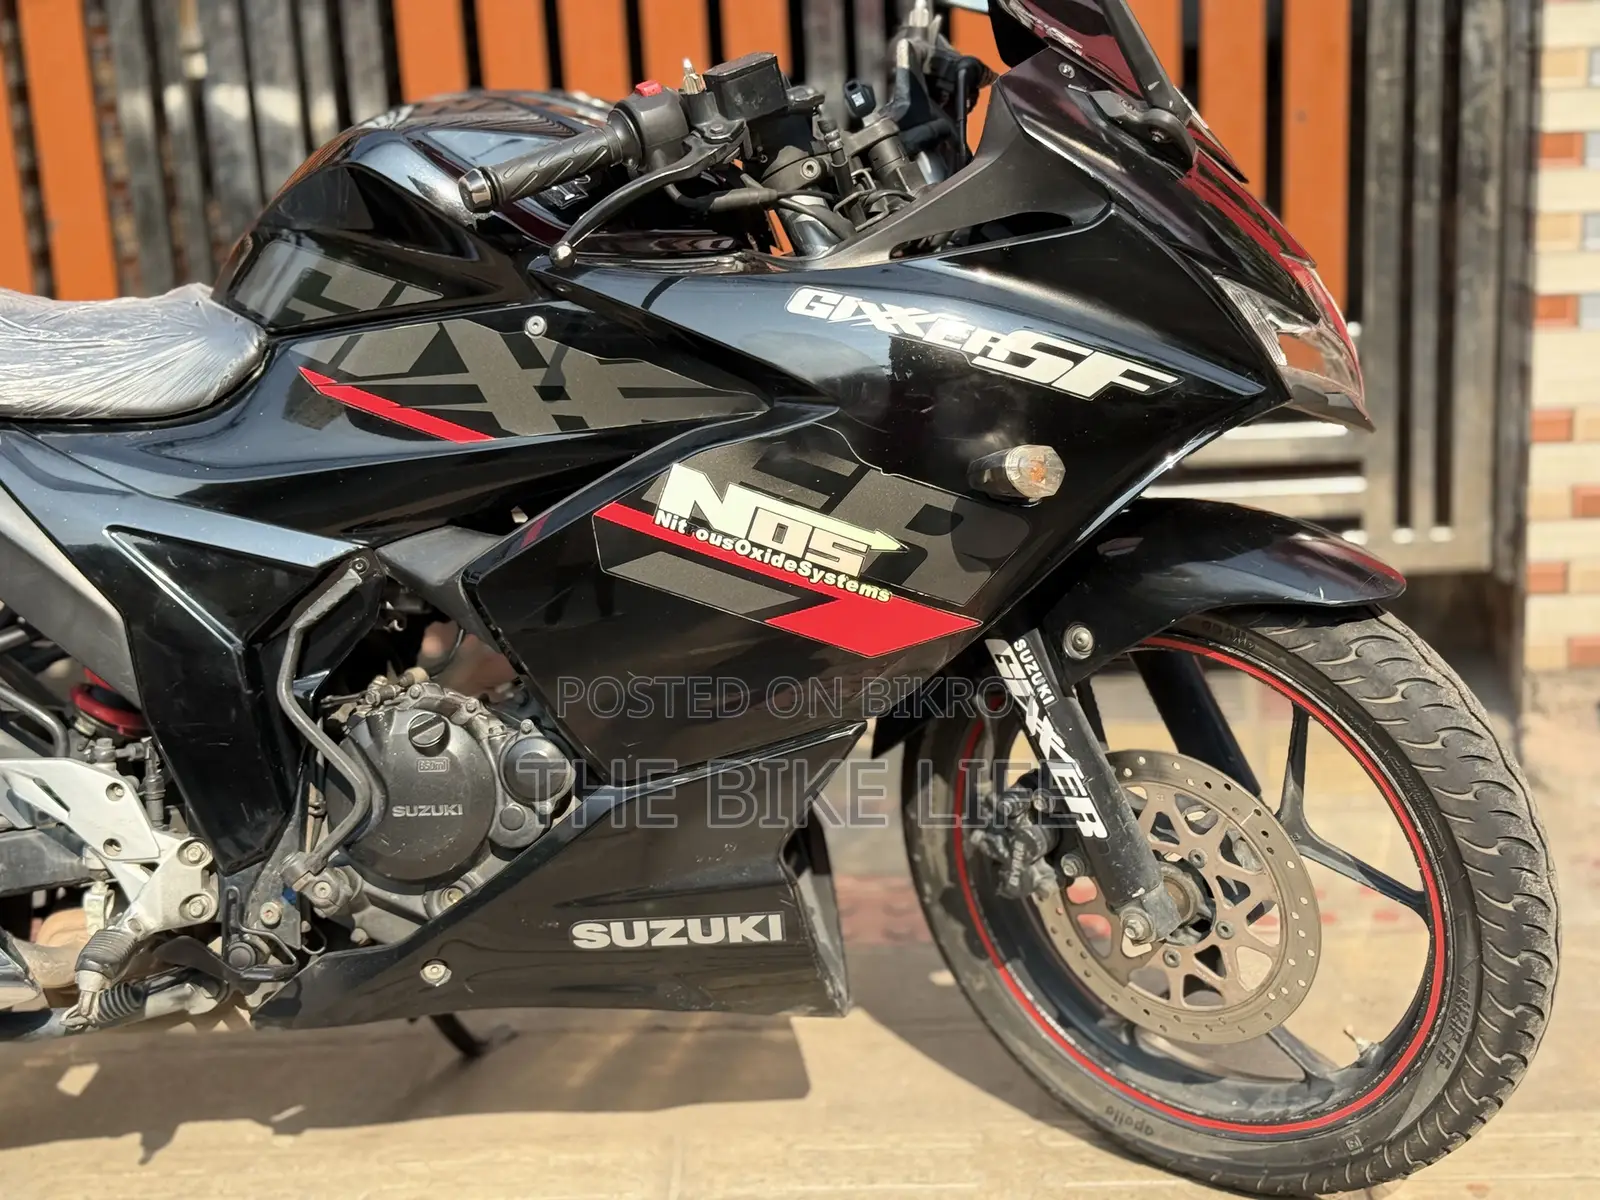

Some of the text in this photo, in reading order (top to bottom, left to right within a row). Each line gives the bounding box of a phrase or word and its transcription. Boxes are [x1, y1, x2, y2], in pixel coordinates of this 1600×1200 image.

[971, 329, 1179, 399] SF
[656, 463, 909, 577] NOS
[1013, 638, 1056, 706] SUZUKI
[392, 803, 464, 818] SUZUKI
[571, 913, 783, 949] SUZUKI
